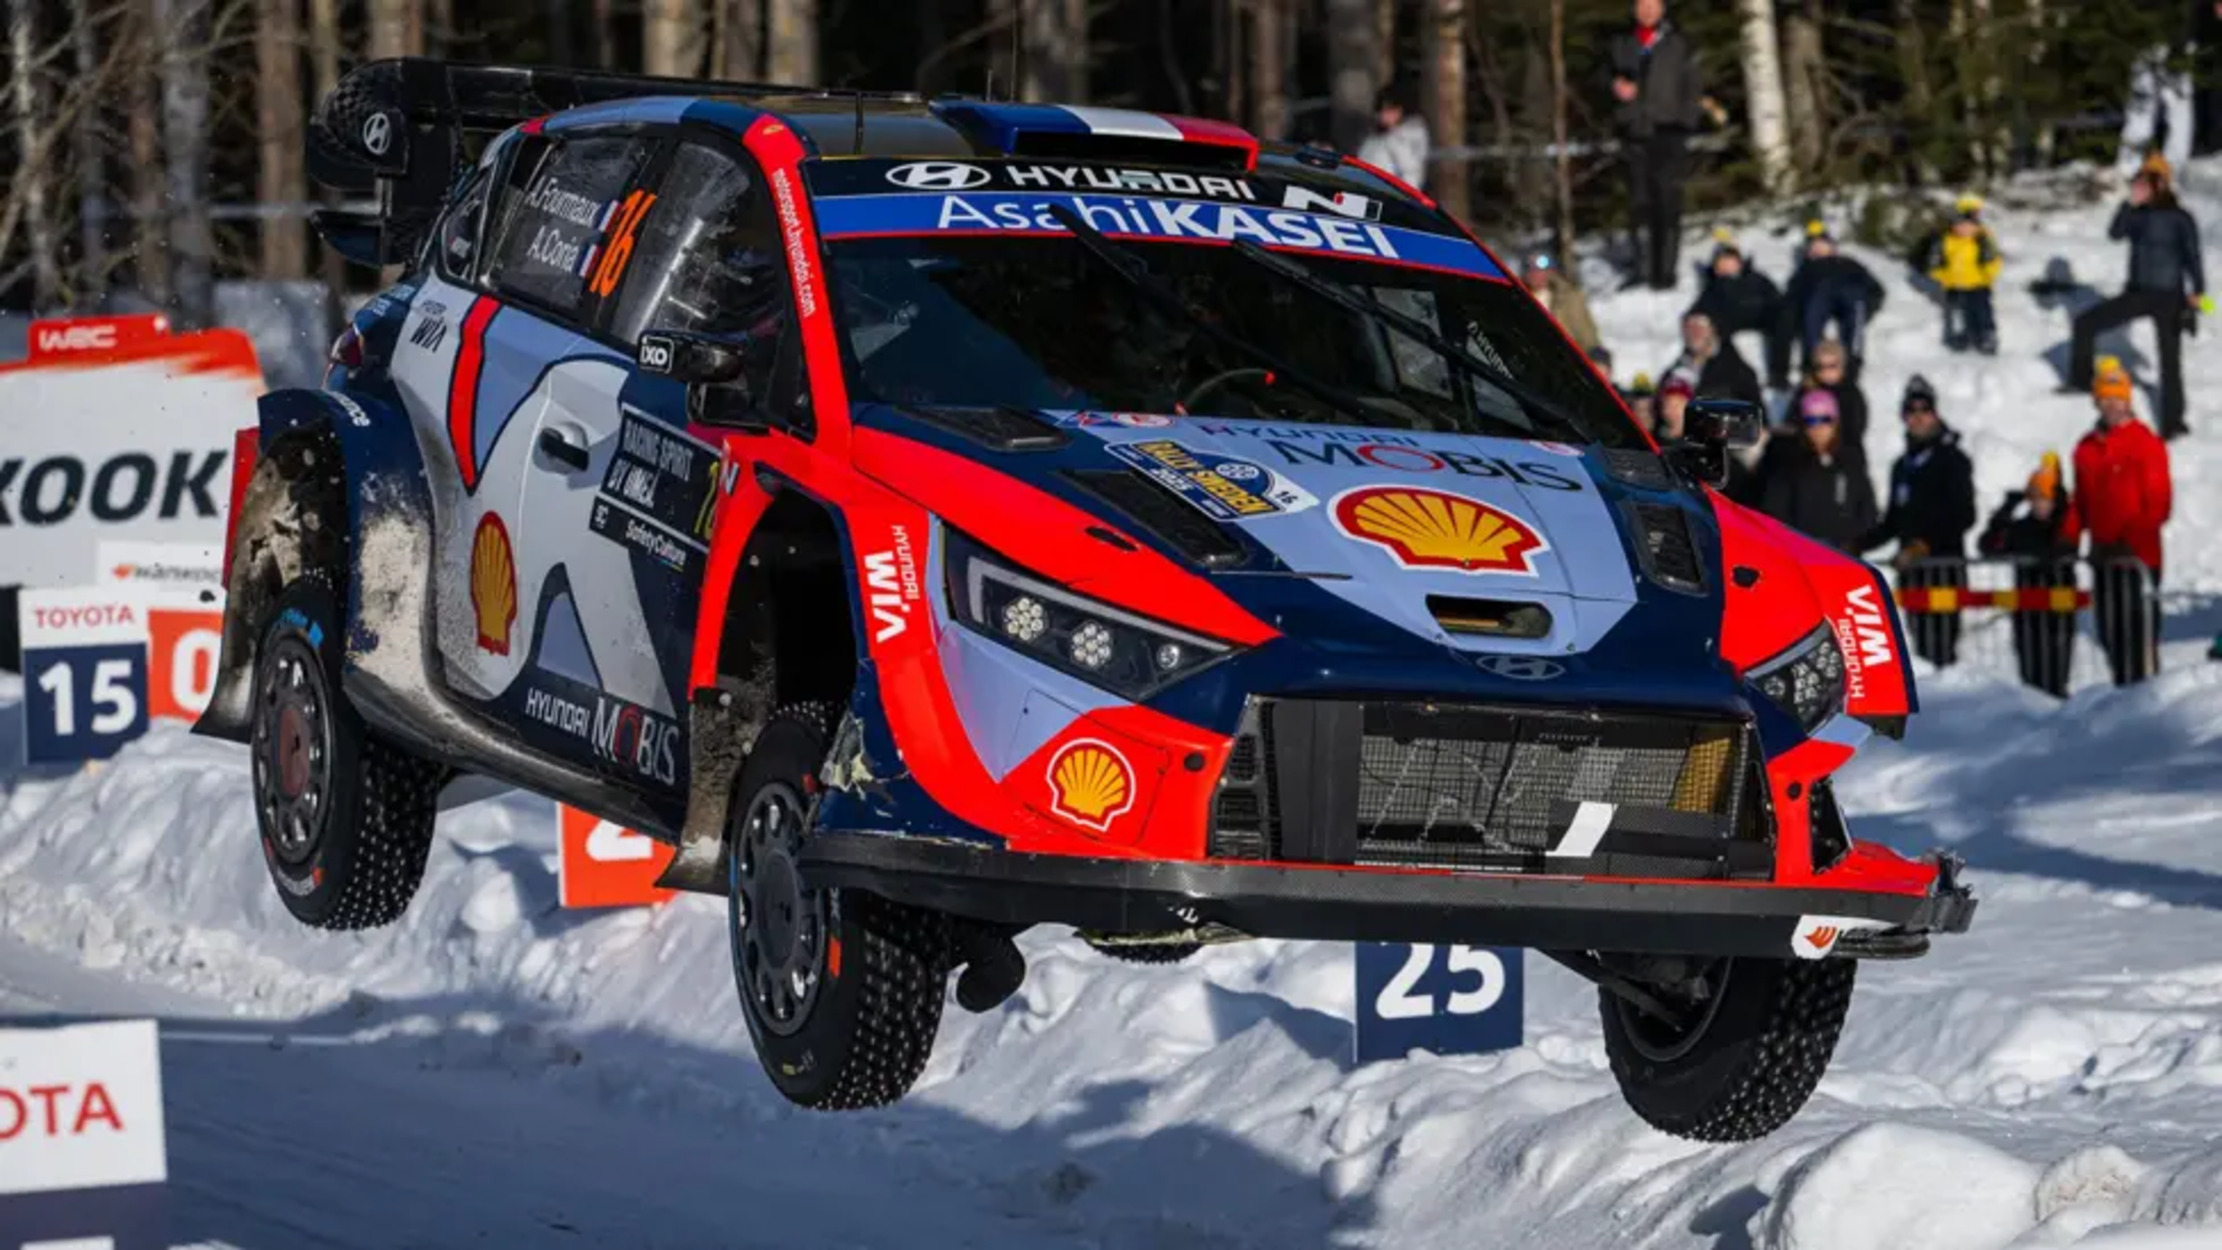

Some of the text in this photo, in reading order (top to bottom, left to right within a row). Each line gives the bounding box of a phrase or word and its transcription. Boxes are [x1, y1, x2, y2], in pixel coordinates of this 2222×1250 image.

[1005, 166, 1256, 200] HYUNDAI
[589, 188, 657, 297] 16
[38, 325, 117, 352] WRC
[1200, 423, 1421, 448] HYUNDAI
[1264, 438, 1583, 492] MOBIS
[864, 550, 911, 644] WIA
[891, 524, 920, 600] HYUNDAI
[35, 605, 135, 629] TOYOTA
[1838, 618, 1865, 698] HYUNDAI
[38, 659, 137, 736] 15
[525, 687, 680, 786] HYUNDAI MOBIS
[1375, 943, 1505, 1019] 25
